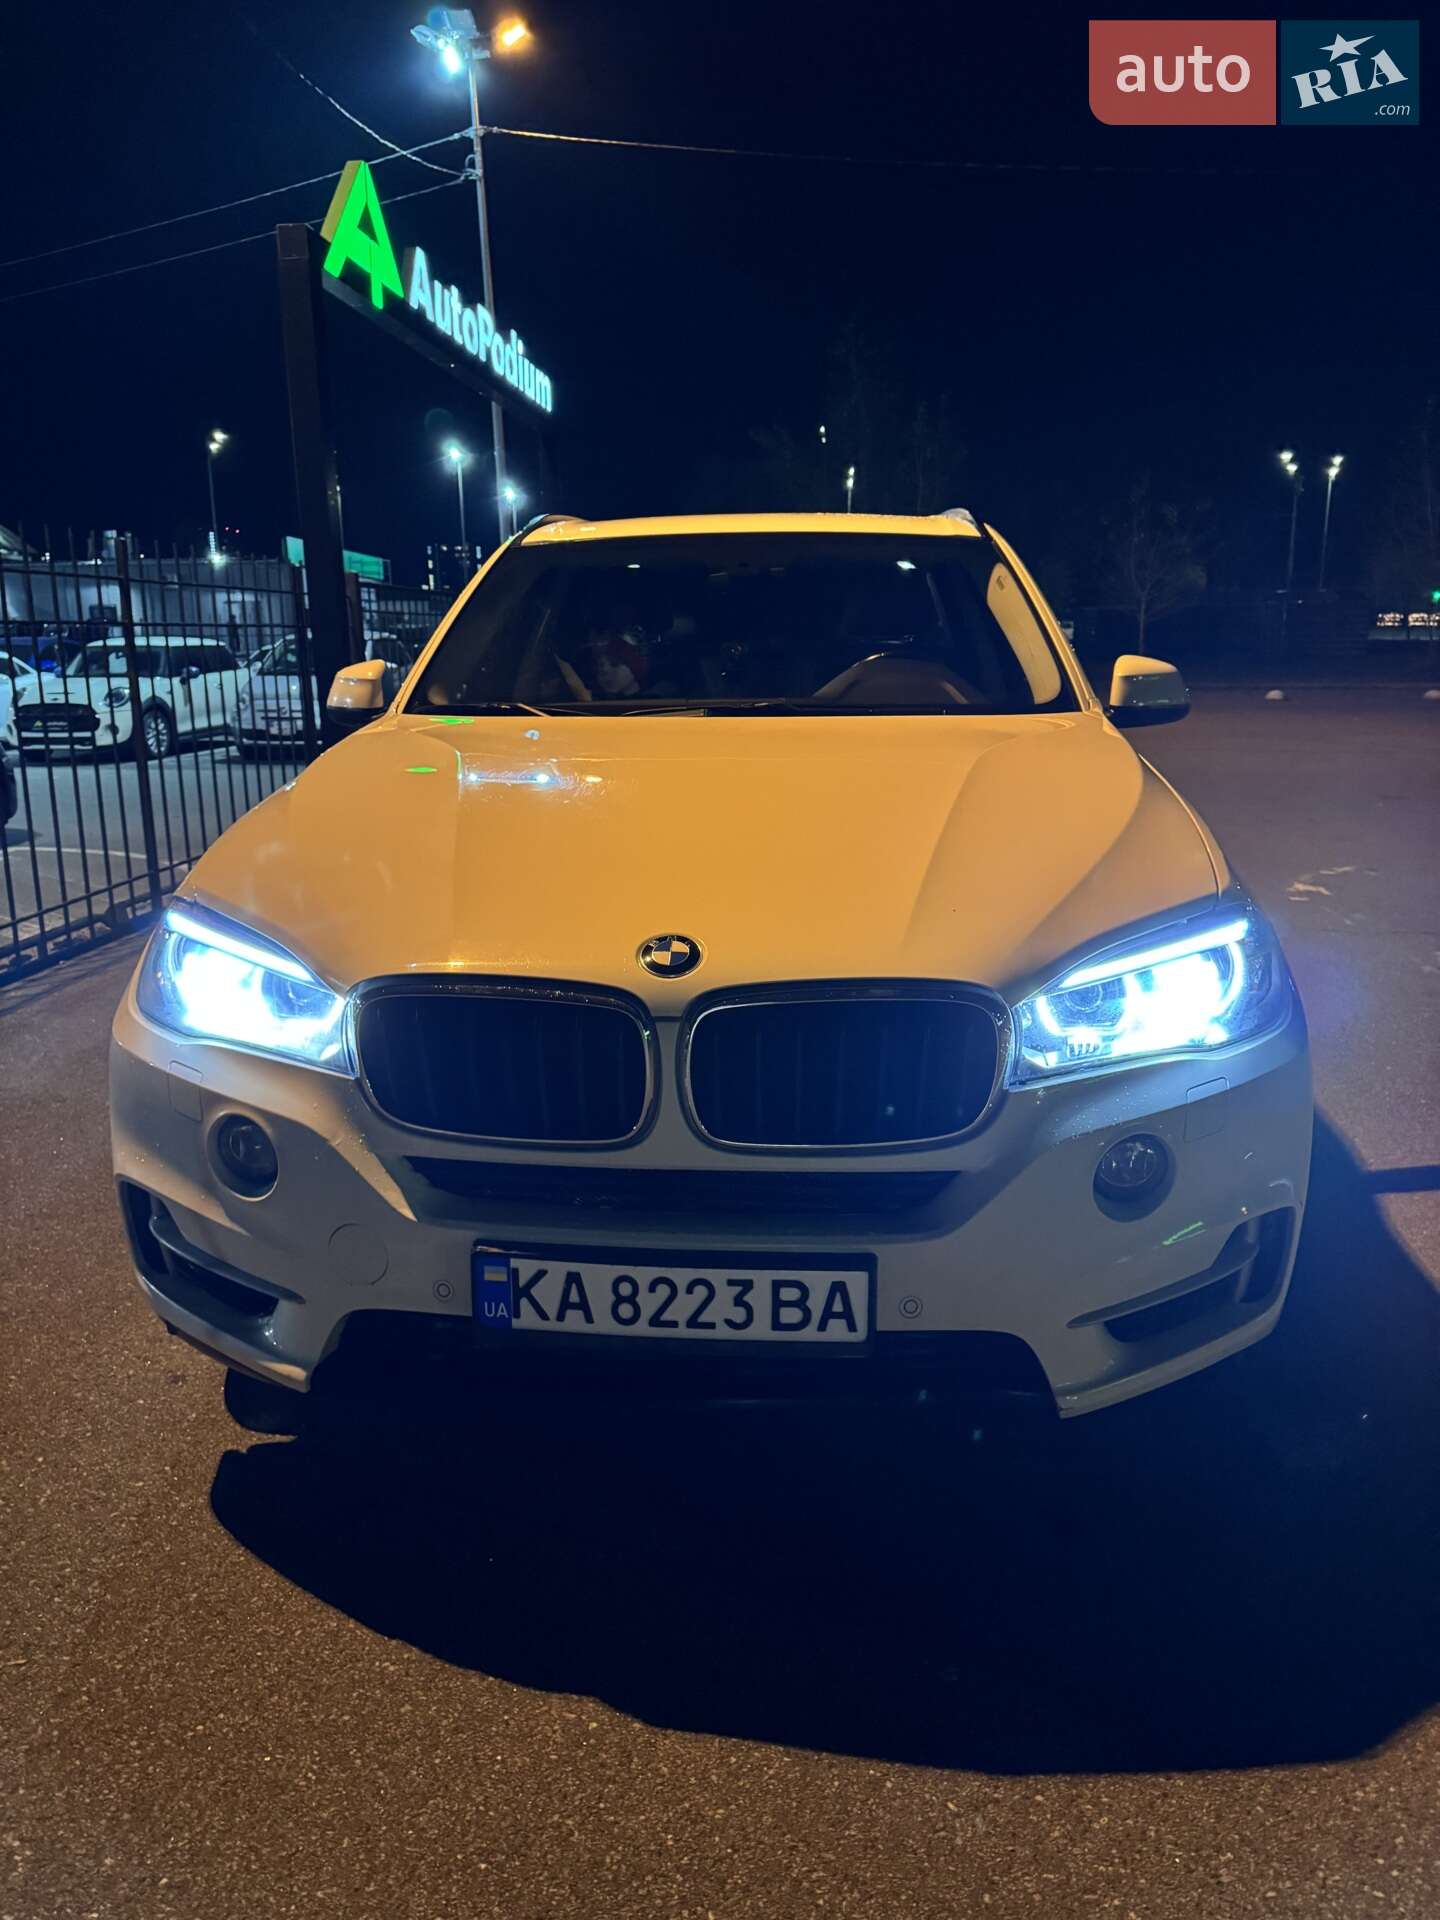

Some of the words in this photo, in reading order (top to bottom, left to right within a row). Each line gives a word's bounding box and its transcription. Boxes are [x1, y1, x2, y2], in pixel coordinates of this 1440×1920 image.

[408, 246, 552, 412] AutoPodium
[484, 1301, 509, 1318] UA
[511, 1267, 595, 1325] KA
[610, 1274, 754, 1331] 8223
[770, 1279, 858, 1333] BA
